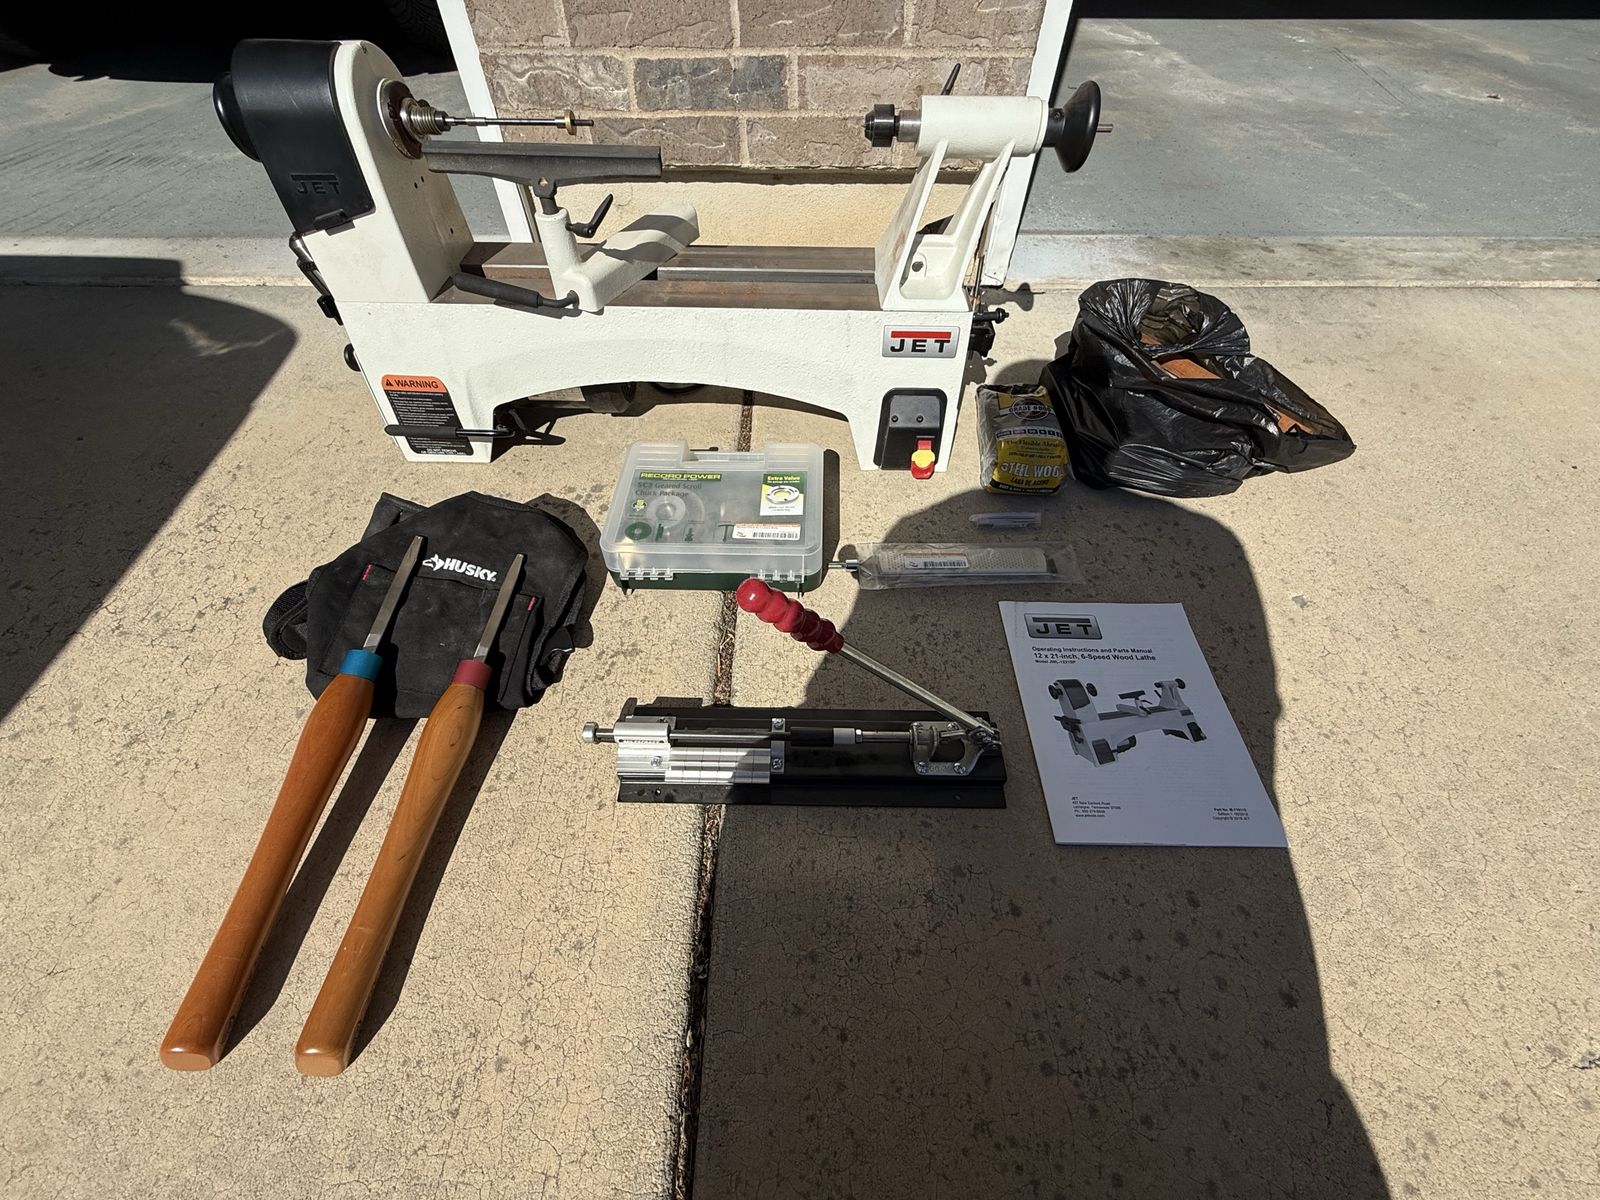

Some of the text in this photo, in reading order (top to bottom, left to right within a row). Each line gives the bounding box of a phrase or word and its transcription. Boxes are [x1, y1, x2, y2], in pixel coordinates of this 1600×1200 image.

[296, 181, 340, 194] JET
[890, 339, 951, 353] JET
[394, 379, 439, 389] WARNING
[1001, 462, 1030, 477] STEEL
[659, 490, 689, 498] Package
[443, 557, 498, 581] HUSKY
[1036, 623, 1092, 635] JET
